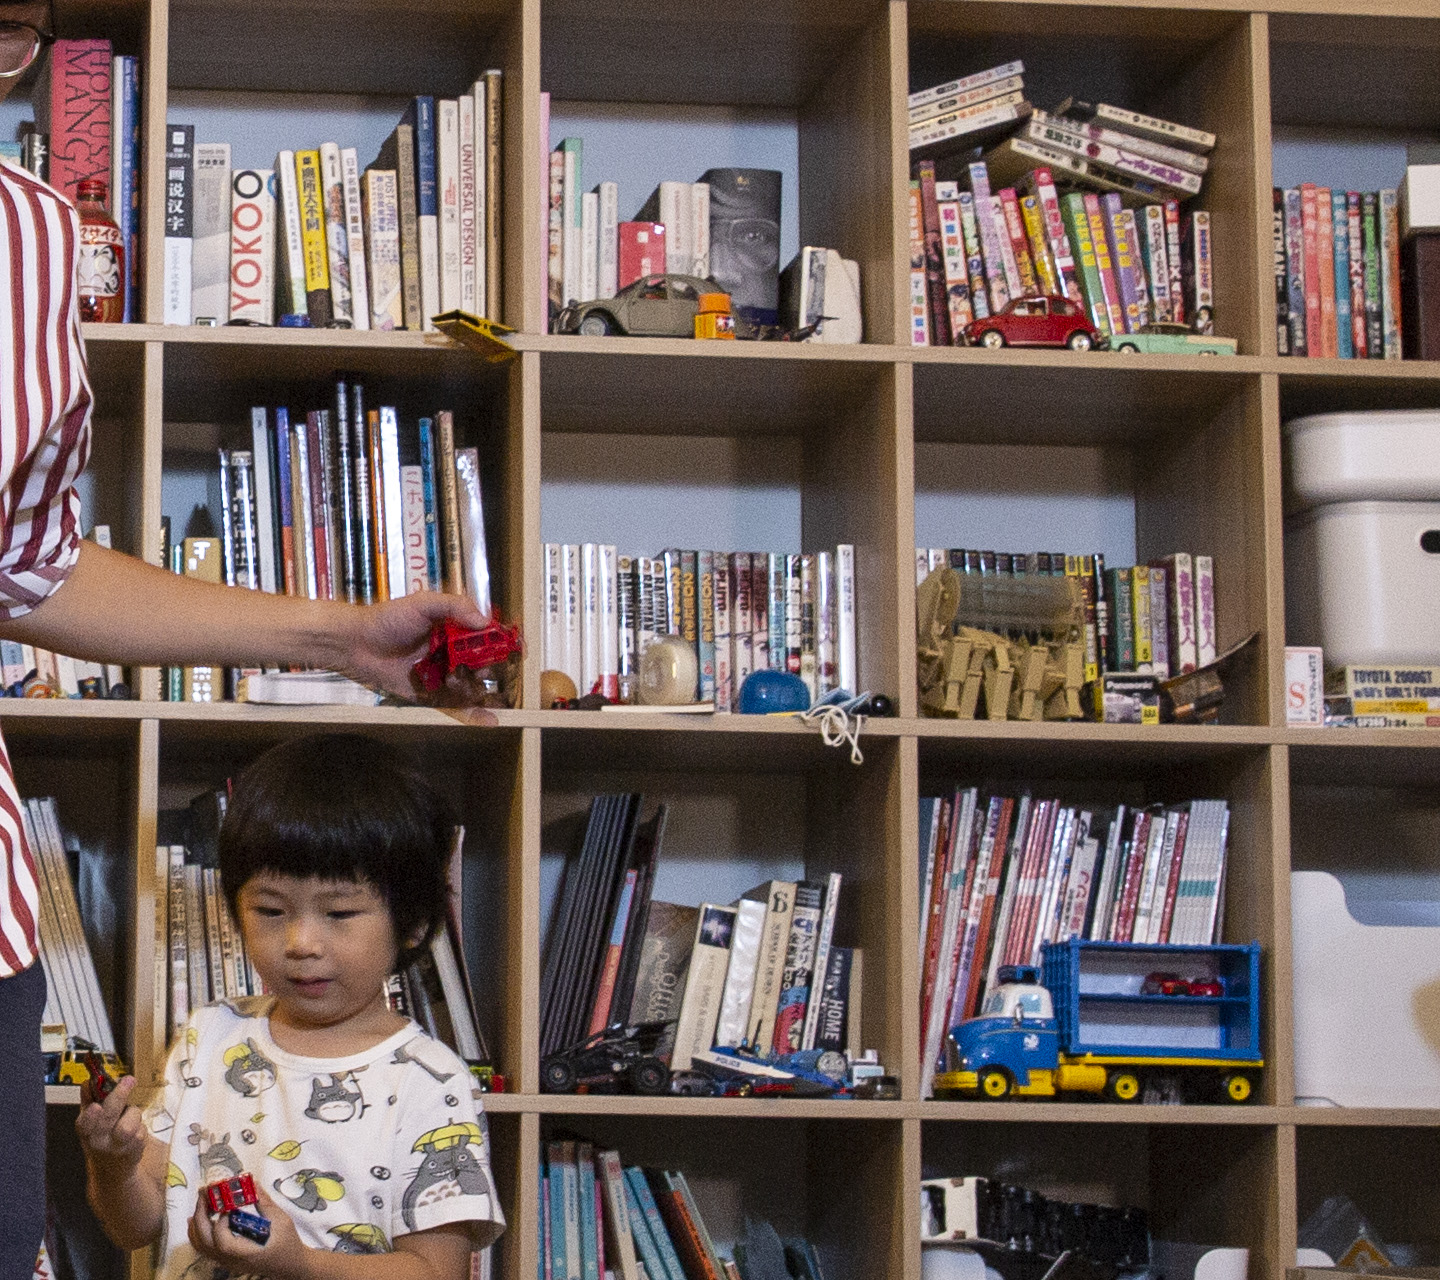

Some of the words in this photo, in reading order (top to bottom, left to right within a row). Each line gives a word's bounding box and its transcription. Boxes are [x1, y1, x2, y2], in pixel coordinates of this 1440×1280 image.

[63, 48, 90, 189] MANGA
[167, 165, 186, 231] 画说汉字
[461, 143, 474, 212] UNIVERSAL
[462, 216, 475, 263] DESIGN
[1106, 681, 1154, 690] Panasonic
[1353, 670, 1392, 684] TOYOTA
[1394, 670, 1433, 684] 2000GT
[825, 1001, 844, 1042] HOME
[716, 1057, 741, 1068] POLICE
